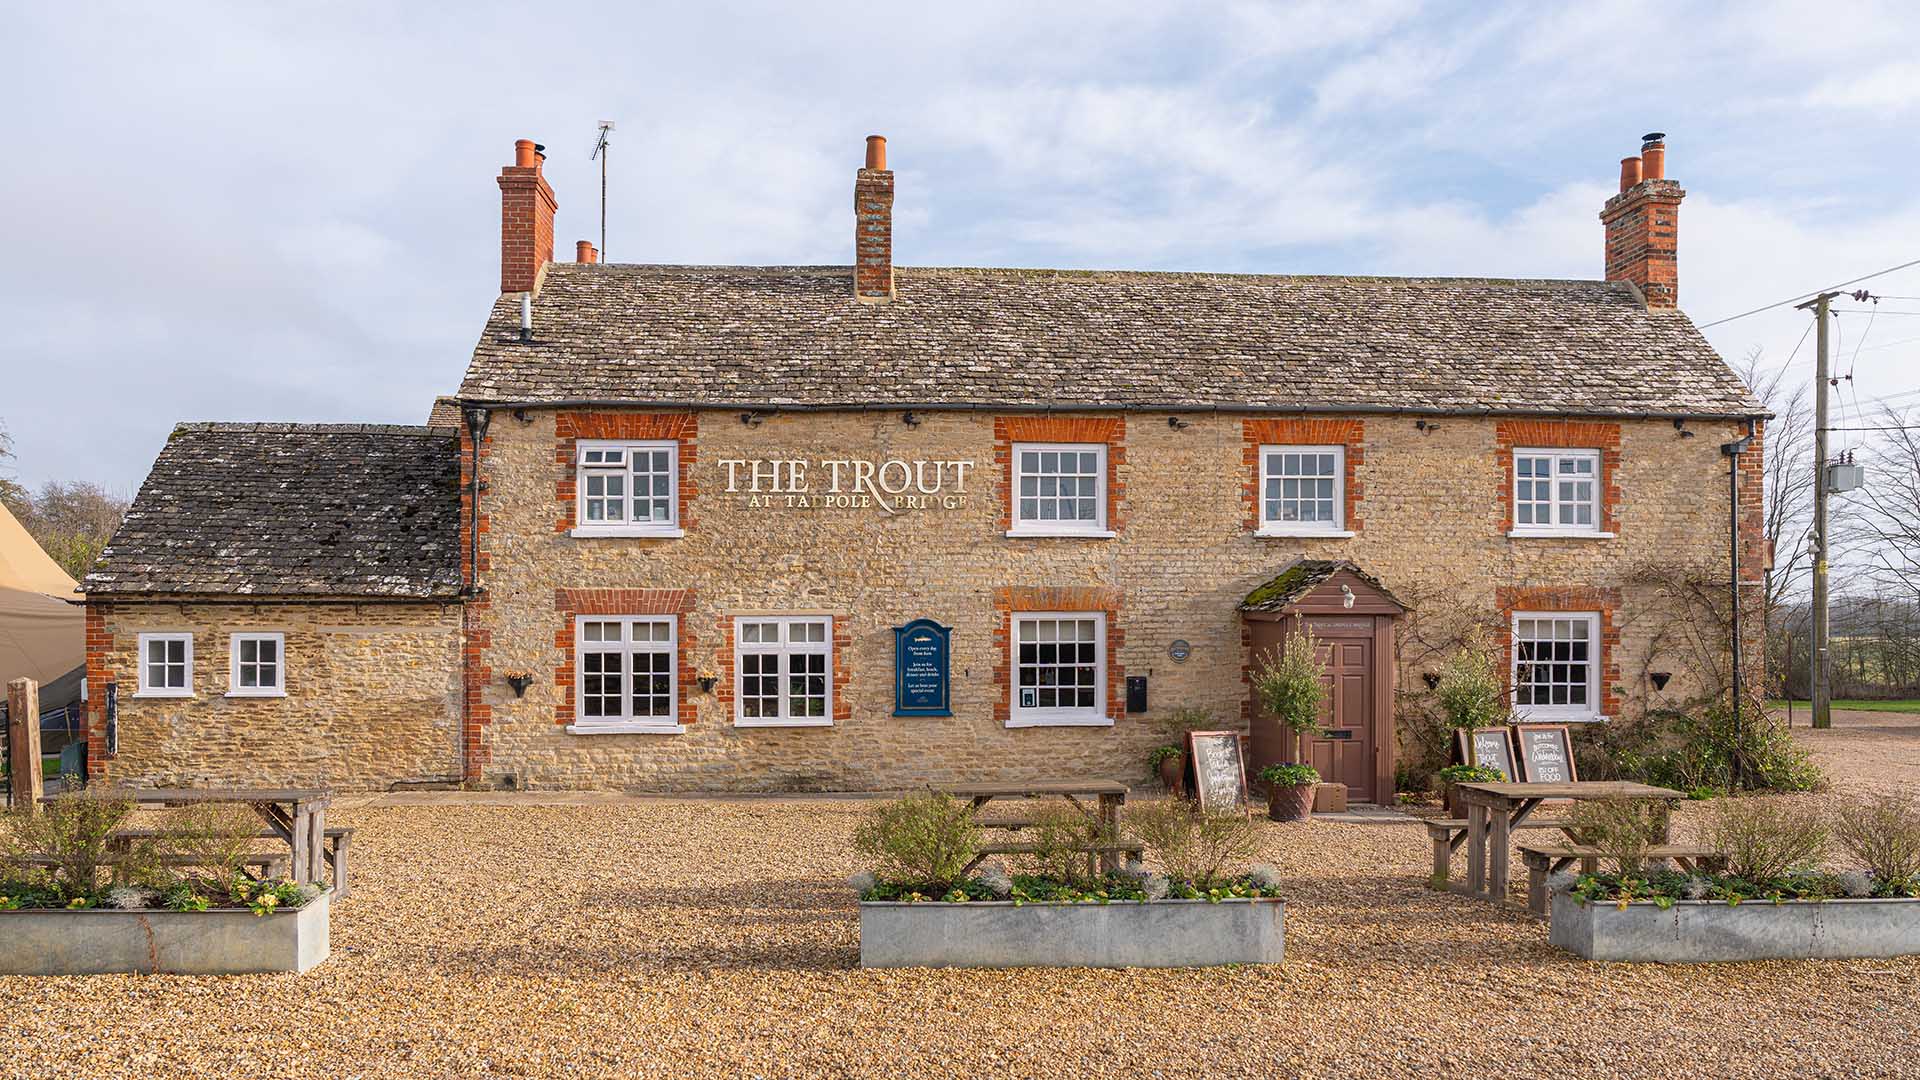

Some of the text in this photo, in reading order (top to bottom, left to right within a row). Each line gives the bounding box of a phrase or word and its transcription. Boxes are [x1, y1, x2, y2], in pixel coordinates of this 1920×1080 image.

[717, 459, 974, 514] THE TROUT
[749, 495, 772, 508] AT
[785, 495, 870, 508] TADPOLE
[1540, 773, 1561, 782] FOOD
